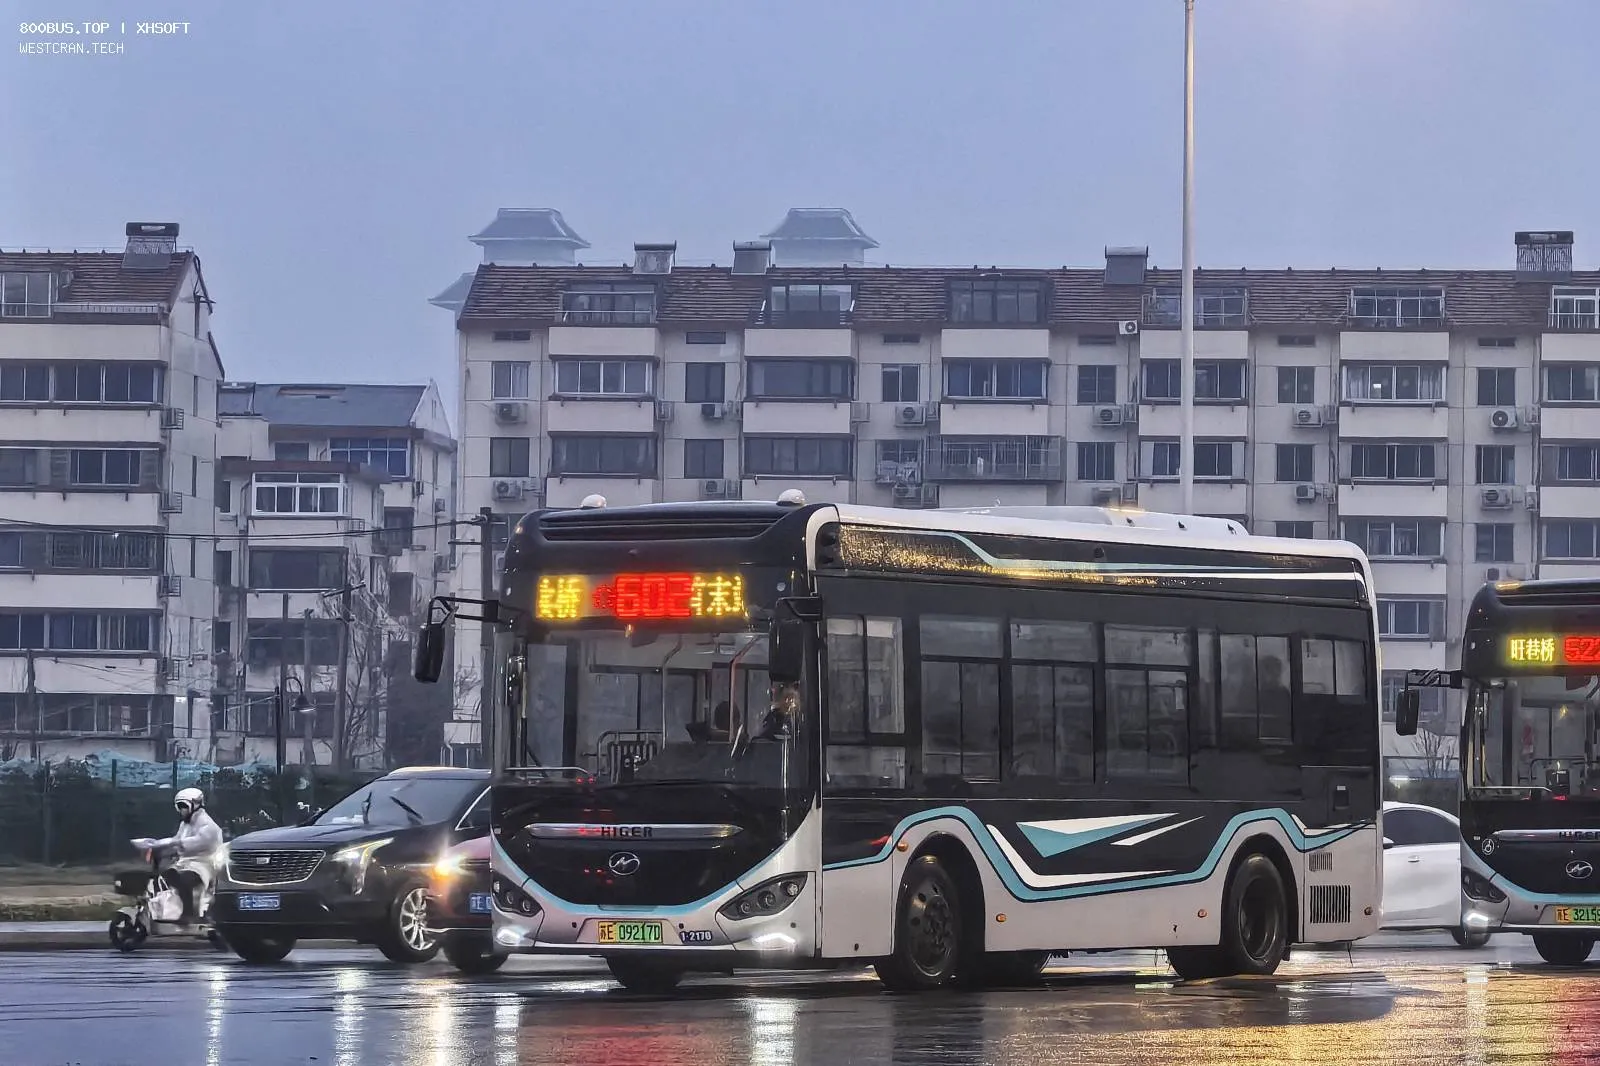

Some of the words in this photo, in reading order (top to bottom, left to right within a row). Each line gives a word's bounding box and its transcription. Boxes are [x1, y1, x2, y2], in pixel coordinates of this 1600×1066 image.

[616, 578, 690, 616] 602
[1511, 638, 1555, 662] 旺巷桥
[601, 826, 653, 838] HIGER
